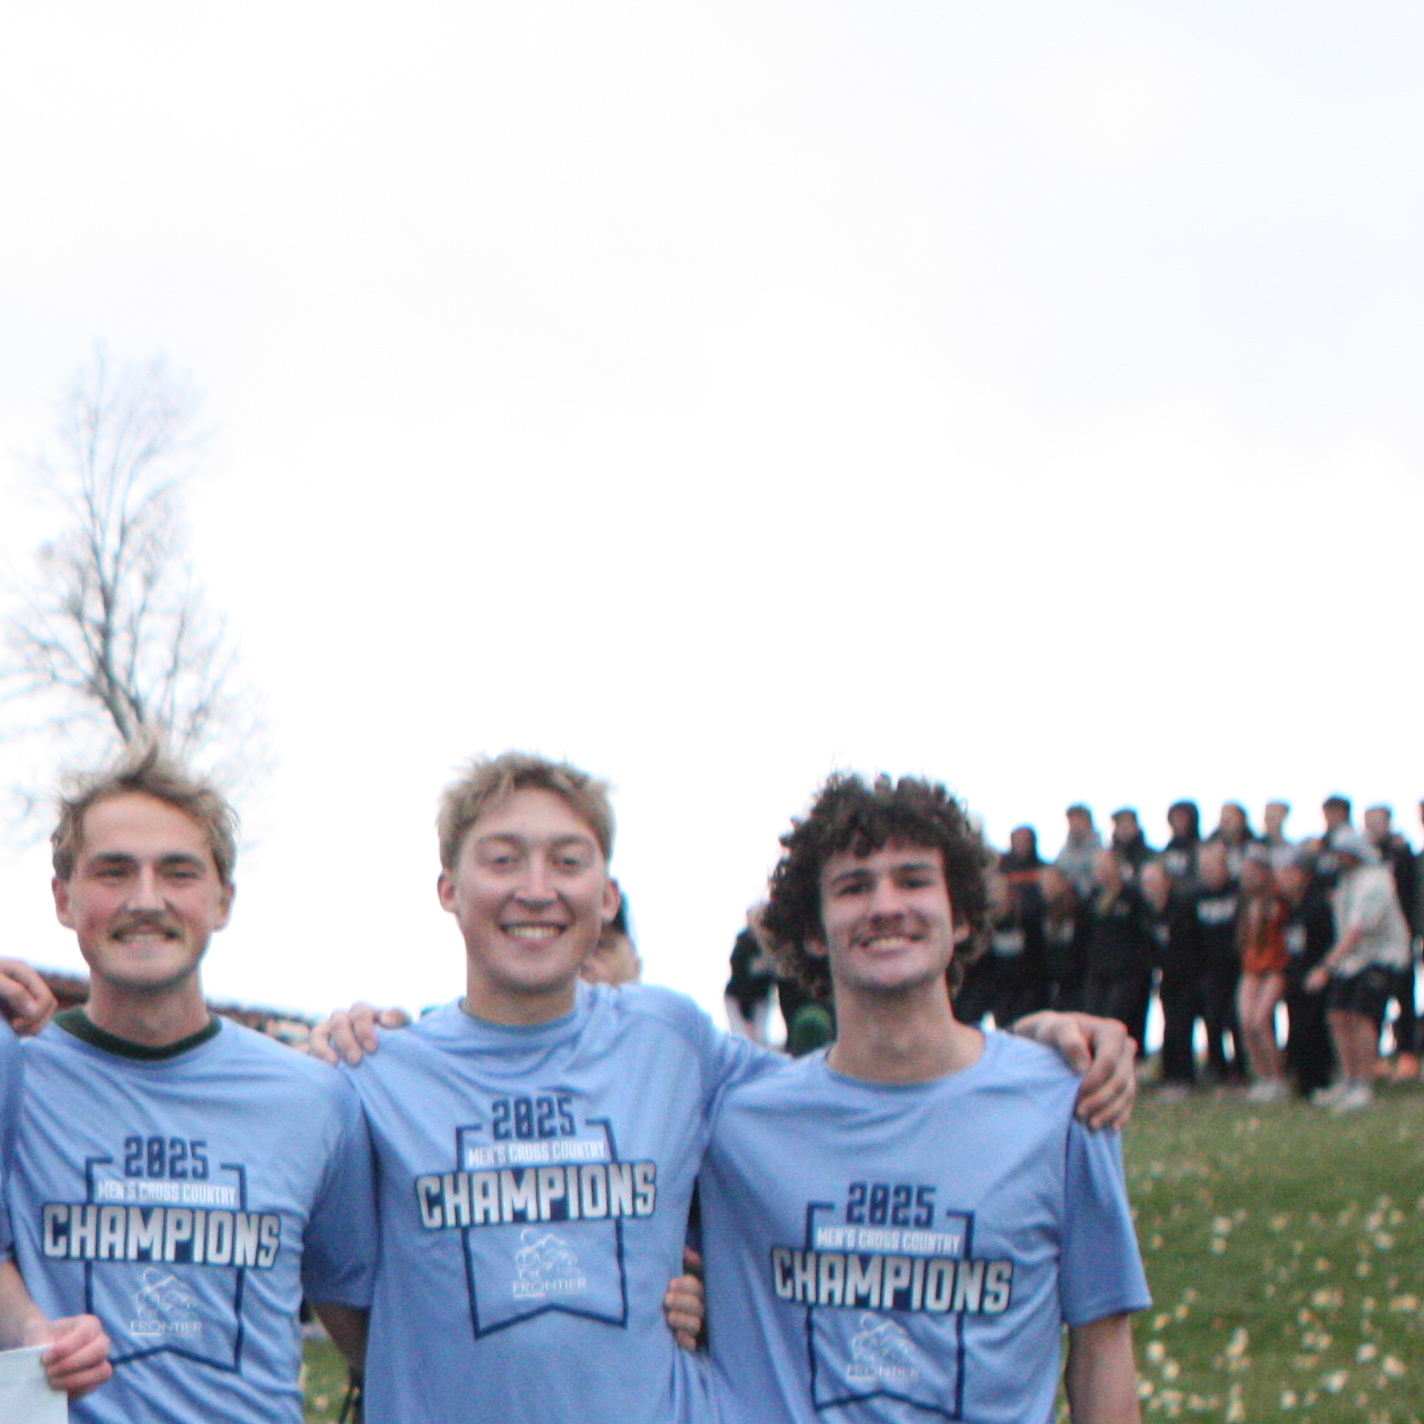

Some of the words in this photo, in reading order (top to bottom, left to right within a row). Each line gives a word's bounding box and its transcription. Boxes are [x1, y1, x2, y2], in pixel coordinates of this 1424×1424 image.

[492, 1096, 577, 1141] 2025
[124, 1136, 209, 1180] 2025
[509, 1143, 550, 1163] CROSS
[552, 1140, 605, 1161] COUNTRY
[416, 1161, 656, 1230] CHAMPIONS
[846, 1181, 937, 1228] 2025
[43, 1203, 280, 1269] CHAMPIONS
[859, 1228, 901, 1250] CROSS
[903, 1231, 961, 1255] COUNTRY
[772, 1248, 1013, 1314] CHAMPIONS
